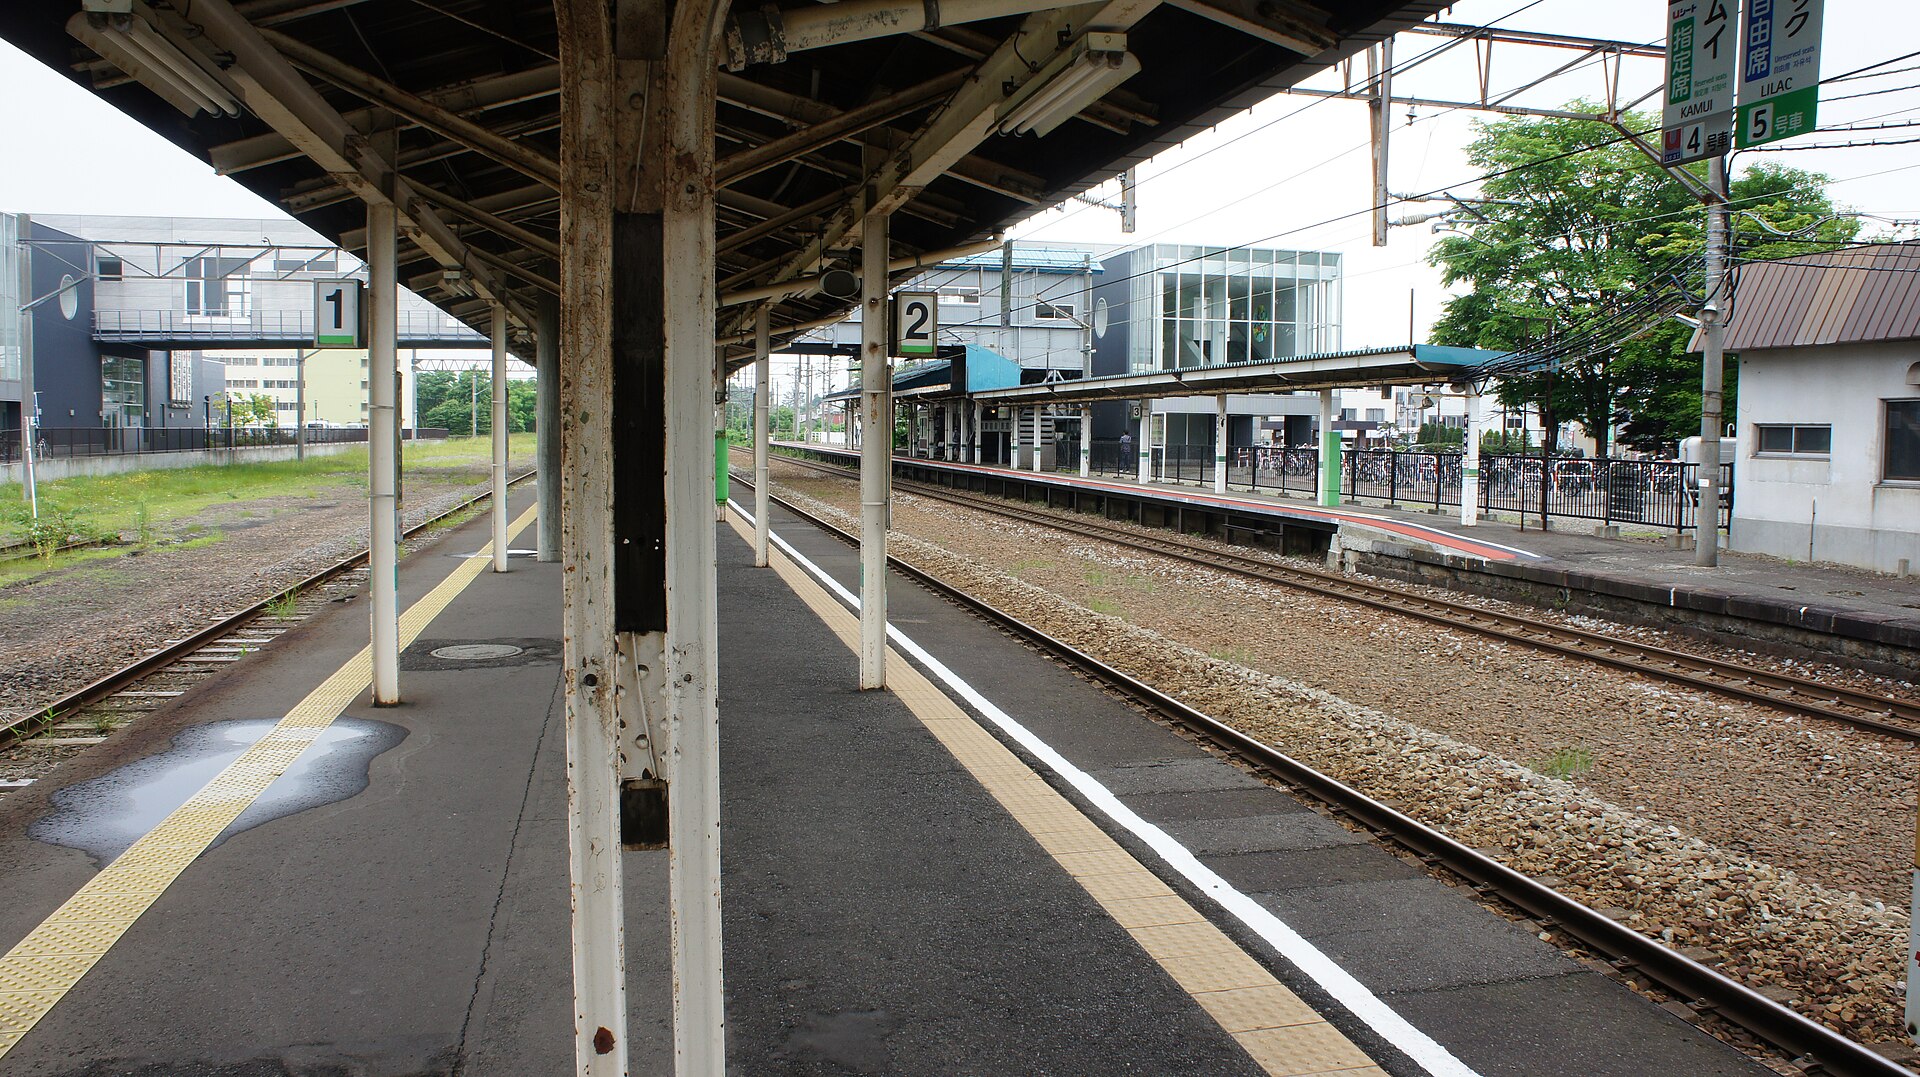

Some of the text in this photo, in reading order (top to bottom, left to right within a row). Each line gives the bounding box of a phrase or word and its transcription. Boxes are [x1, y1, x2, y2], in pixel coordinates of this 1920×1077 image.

[1670, 26, 1693, 100] 指定席
[1774, 51, 1802, 63] Unreserved
[1760, 77, 1793, 97] LILAC
[1680, 100, 1713, 119] KAMUI
[1752, 109, 1804, 138] 5 号車
[1687, 127, 1729, 154] 4 号車
[325, 288, 342, 329] 1
[906, 302, 929, 340] 2
[1133, 407, 1140, 417] 3
